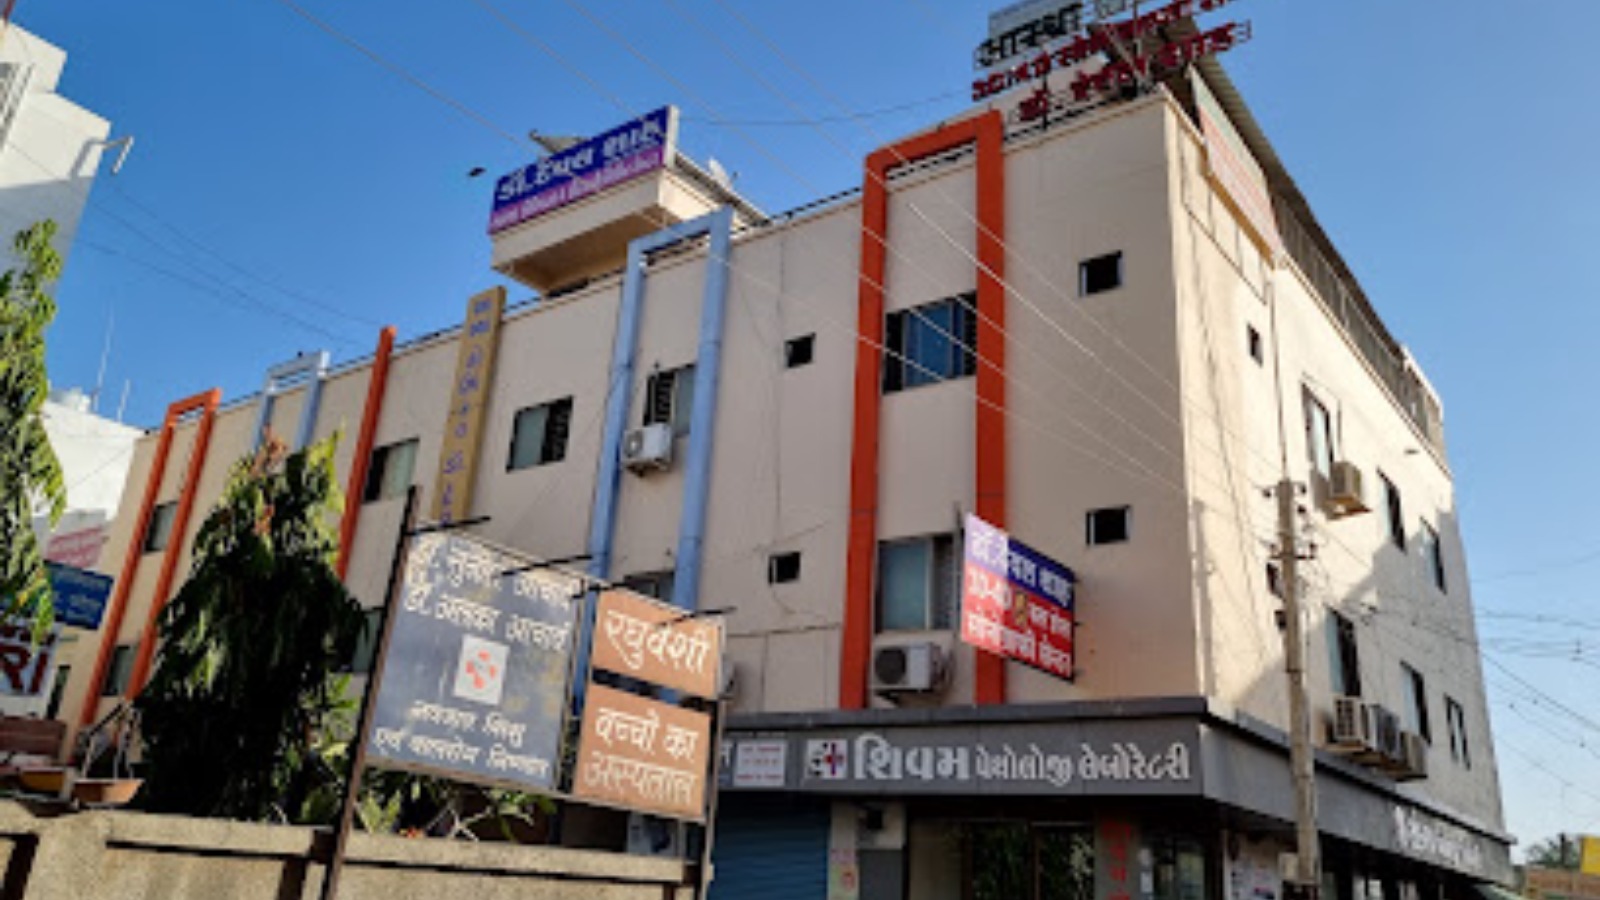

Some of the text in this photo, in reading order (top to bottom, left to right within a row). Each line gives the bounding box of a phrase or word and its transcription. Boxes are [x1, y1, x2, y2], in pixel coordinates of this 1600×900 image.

[482, 711, 527, 749] शिशु
[663, 723, 699, 763] का
[854, 733, 969, 780] શિવમ
